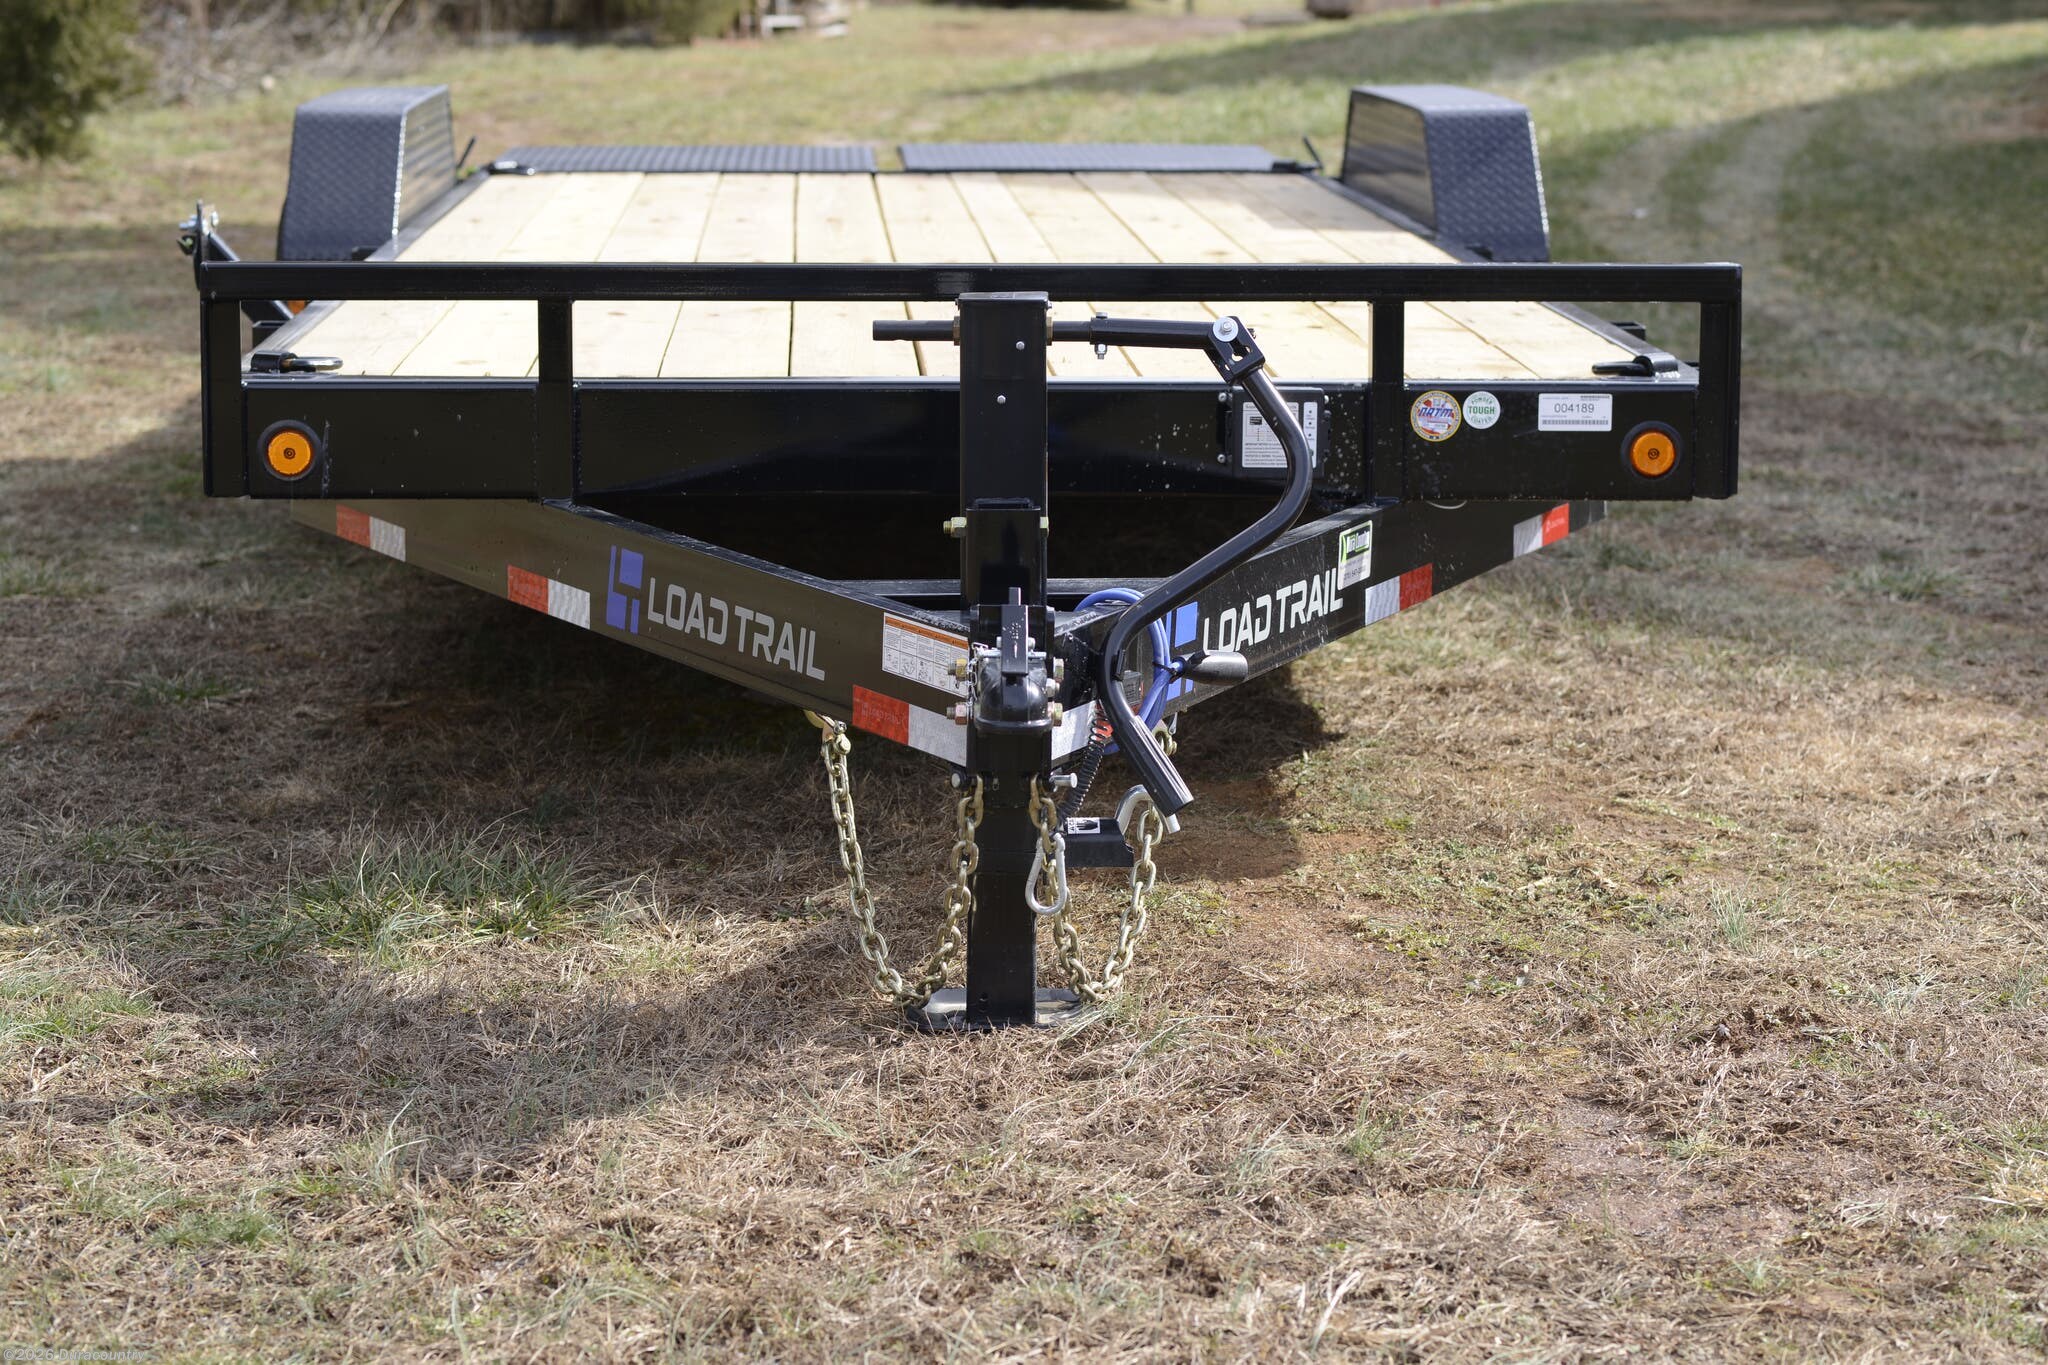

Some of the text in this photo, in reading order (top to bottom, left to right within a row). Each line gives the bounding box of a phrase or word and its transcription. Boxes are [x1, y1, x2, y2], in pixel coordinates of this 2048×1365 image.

[1418, 407, 1453, 417] NATM
[1468, 406, 1495, 414] TOUGH
[1554, 403, 1595, 413] 004189
